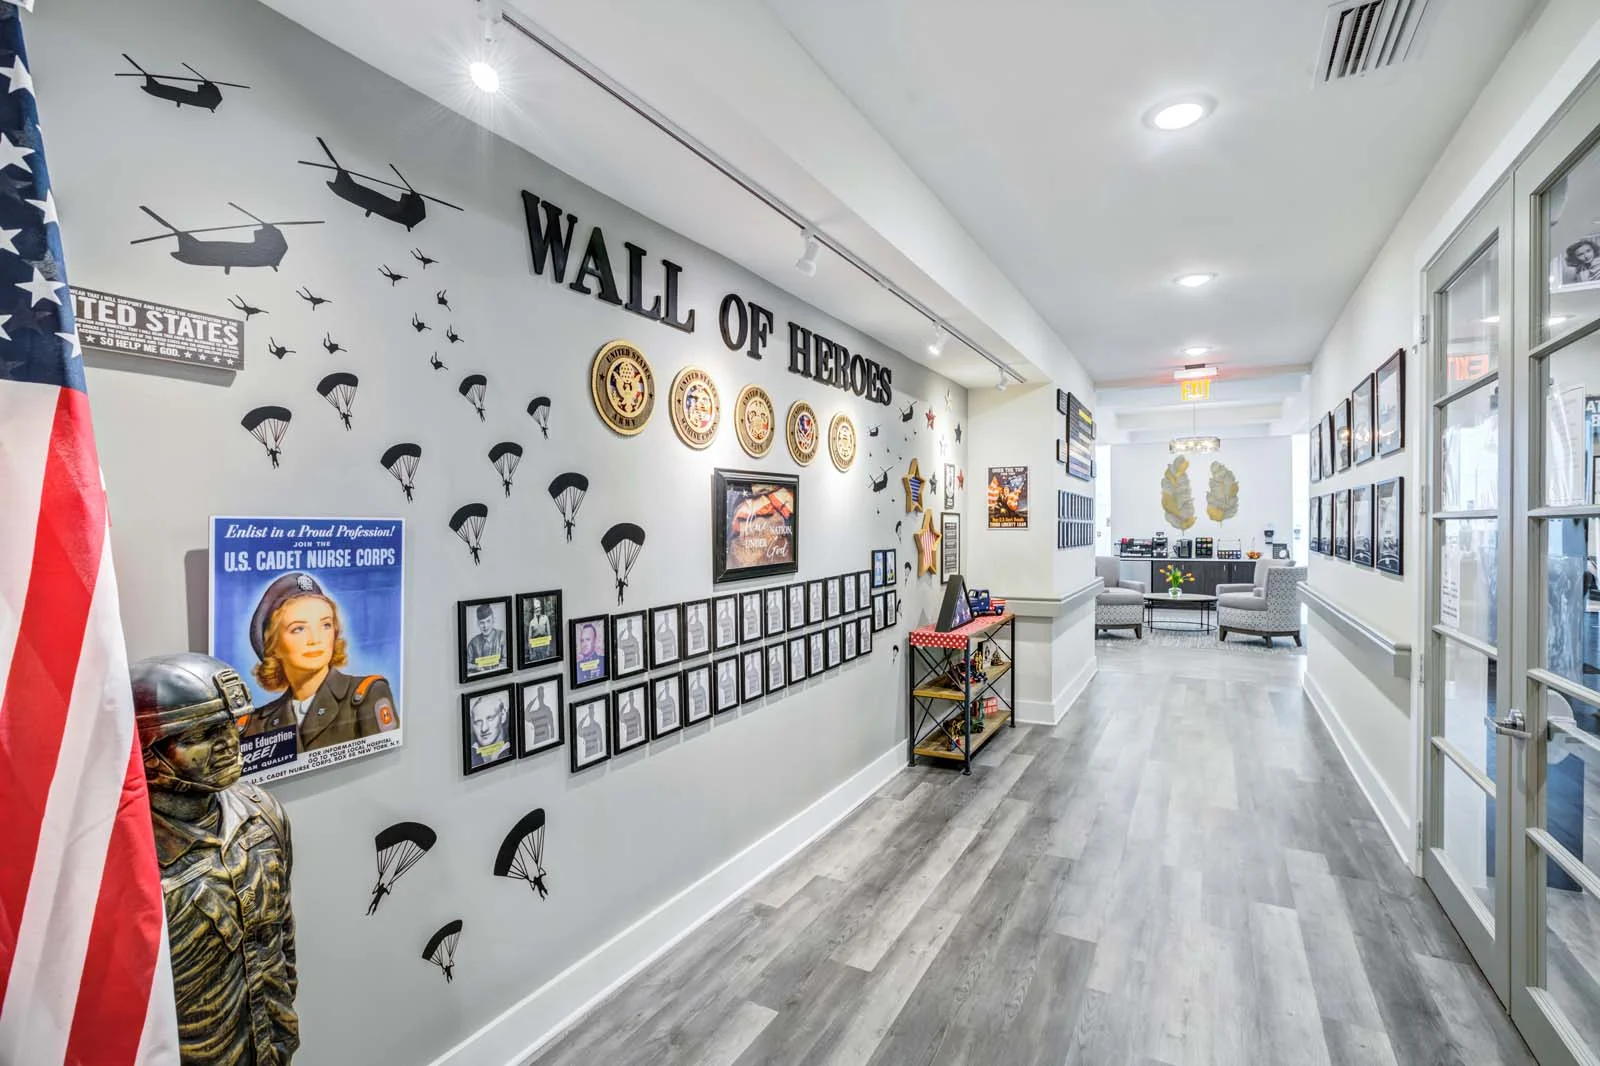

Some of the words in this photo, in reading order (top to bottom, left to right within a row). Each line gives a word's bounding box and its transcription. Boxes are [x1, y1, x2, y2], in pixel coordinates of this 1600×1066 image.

[521, 189, 695, 333] WALL
[719, 293, 773, 360] OF
[788, 321, 892, 406] HEROES
[145, 310, 239, 346] STATES
[100, 336, 114, 346] SO
[116, 339, 141, 350] HELP
[143, 343, 158, 353] ME
[160, 346, 181, 357] GOD.
[606, 348, 630, 364] UNITED
[631, 351, 652, 380] STATES
[612, 413, 636, 426] ARMY
[224, 524, 267, 539] Enlist
[270, 526, 284, 538] in
[287, 529, 296, 538] a
[298, 525, 333, 538] Proud
[335, 525, 396, 540] Profession!
[224, 551, 252, 572] U.S.
[256, 550, 302, 570] CADET
[307, 549, 351, 569] NURSE
[355, 548, 395, 566] CORPS
[255, 731, 296, 749] Education-
[323, 740, 366, 754] INFORMATION
[330, 750, 346, 758] YOUR
[347, 745, 365, 753] LOCAL
[367, 737, 392, 748] HOSPITAL
[243, 743, 277, 763] REE!
[243, 764, 258, 773] CAN
[261, 754, 294, 767] QUALIFY
[266, 770, 287, 780] CADET
[288, 764, 310, 774] NURSE
